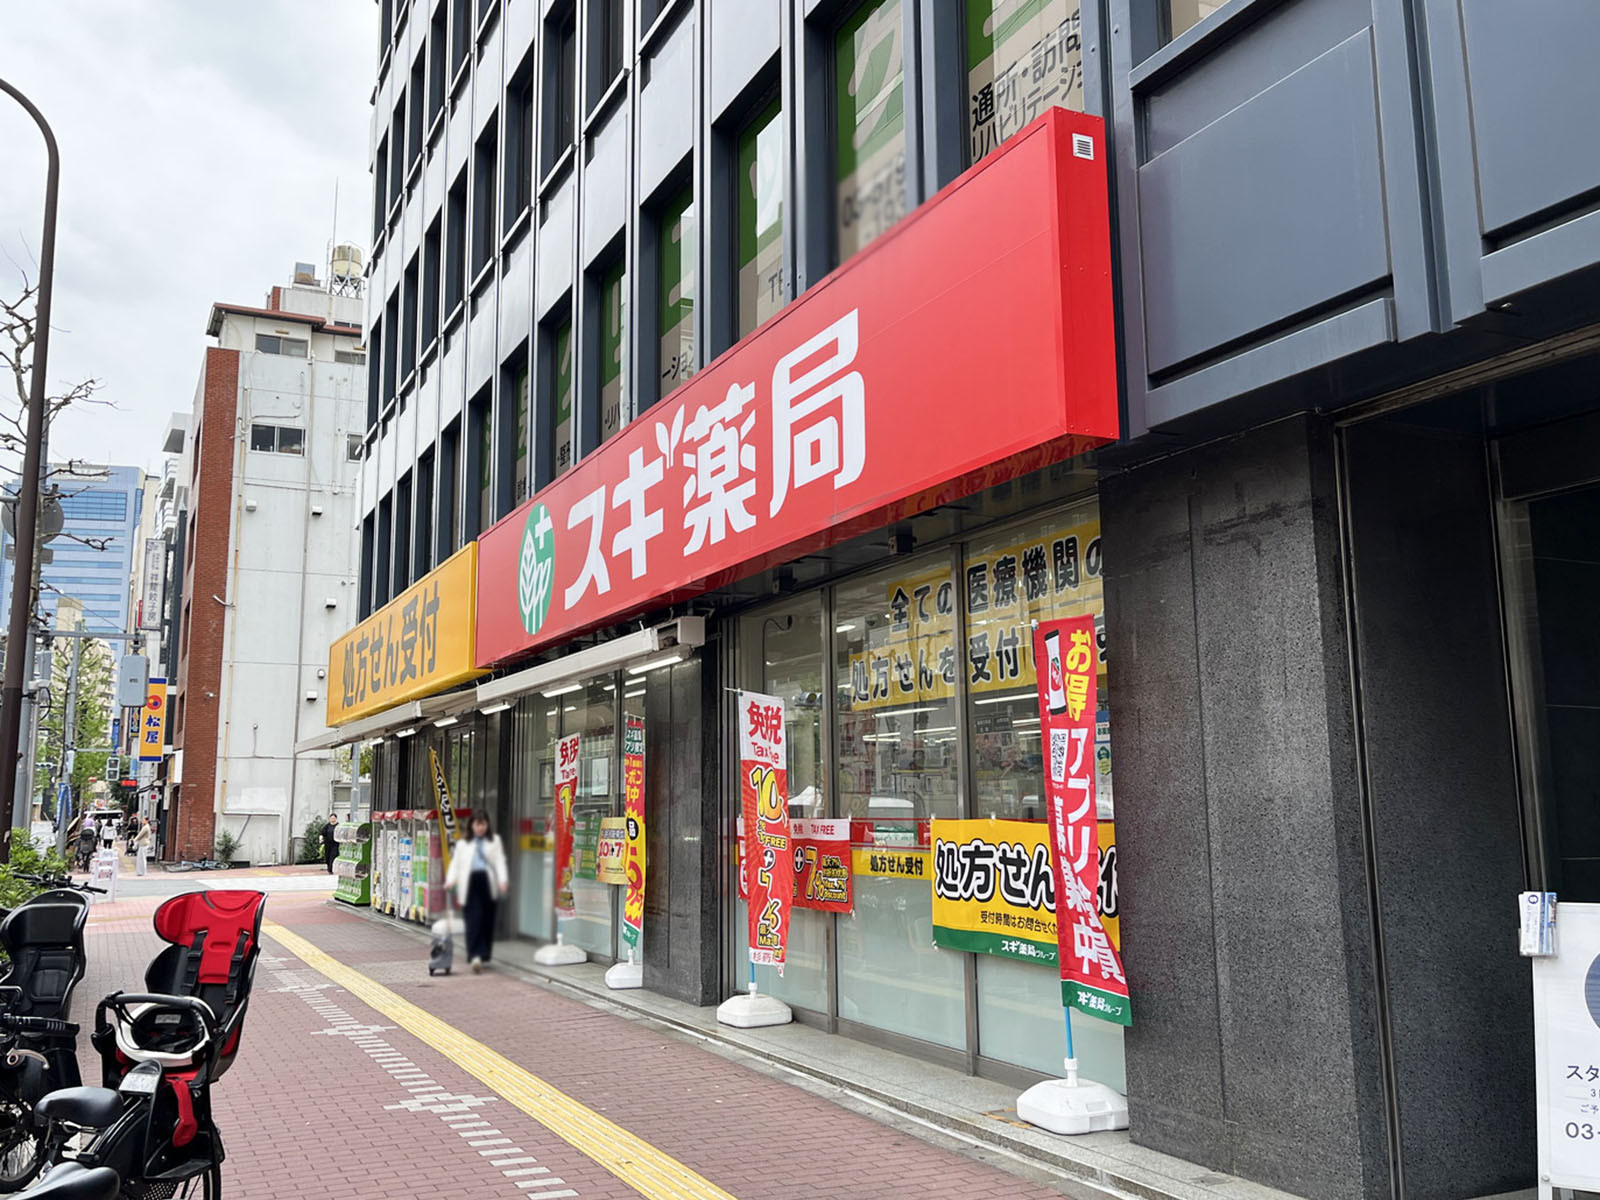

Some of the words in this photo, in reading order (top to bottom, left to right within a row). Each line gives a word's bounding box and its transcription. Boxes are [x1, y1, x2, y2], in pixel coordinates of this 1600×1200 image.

[564, 308, 866, 611] スギ薬局
[342, 580, 441, 710] 処方せん受付
[145, 714, 161, 744] 松屋
[870, 854, 924, 876] 処方せん受付
[1001, 939, 1056, 960] スギ薬局グループ
